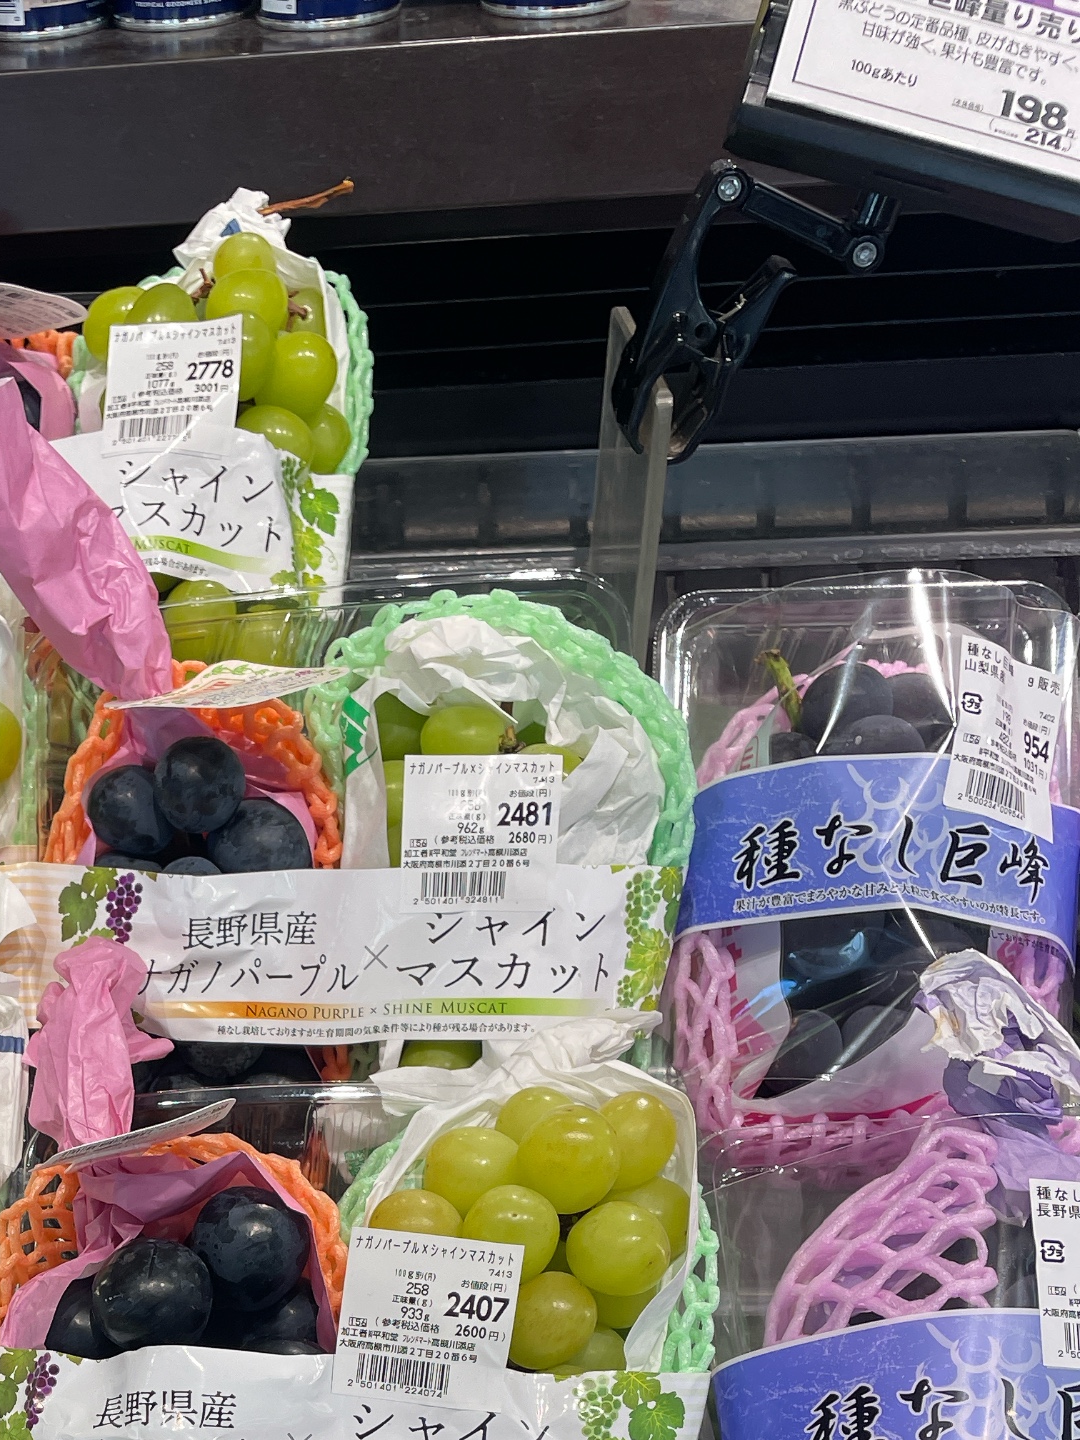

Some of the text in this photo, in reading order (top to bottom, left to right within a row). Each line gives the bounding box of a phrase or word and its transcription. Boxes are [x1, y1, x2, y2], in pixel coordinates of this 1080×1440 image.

[851, 59, 918, 88] 100gあたり
[1001, 88, 1068, 132] 198
[1024, 127, 1063, 151] 214
[185, 359, 234, 381] 2778
[117, 459, 275, 503] シャイン
[964, 658, 1006, 685] 山梨県産
[1024, 731, 1050, 763] 954
[409, 761, 555, 775] ナガノパープル×シインマスカット
[497, 801, 552, 827] 2481
[734, 813, 1050, 904] 種なし巨峰
[182, 910, 317, 950] 長野県産
[427, 908, 606, 946] シャイン
[138, 954, 359, 996] ナガノパープル
[396, 953, 609, 993] マスカット
[245, 1001, 508, 1020] NAGANO PURPLE SHINE MUSCAT
[488, 1268, 513, 1279] 7413
[400, 1306, 430, 1322] 933g
[406, 1282, 510, 1323] 258 2407
[360, 1380, 442, 1398] 501401 224074
[93, 1390, 237, 1429] 長野県産
